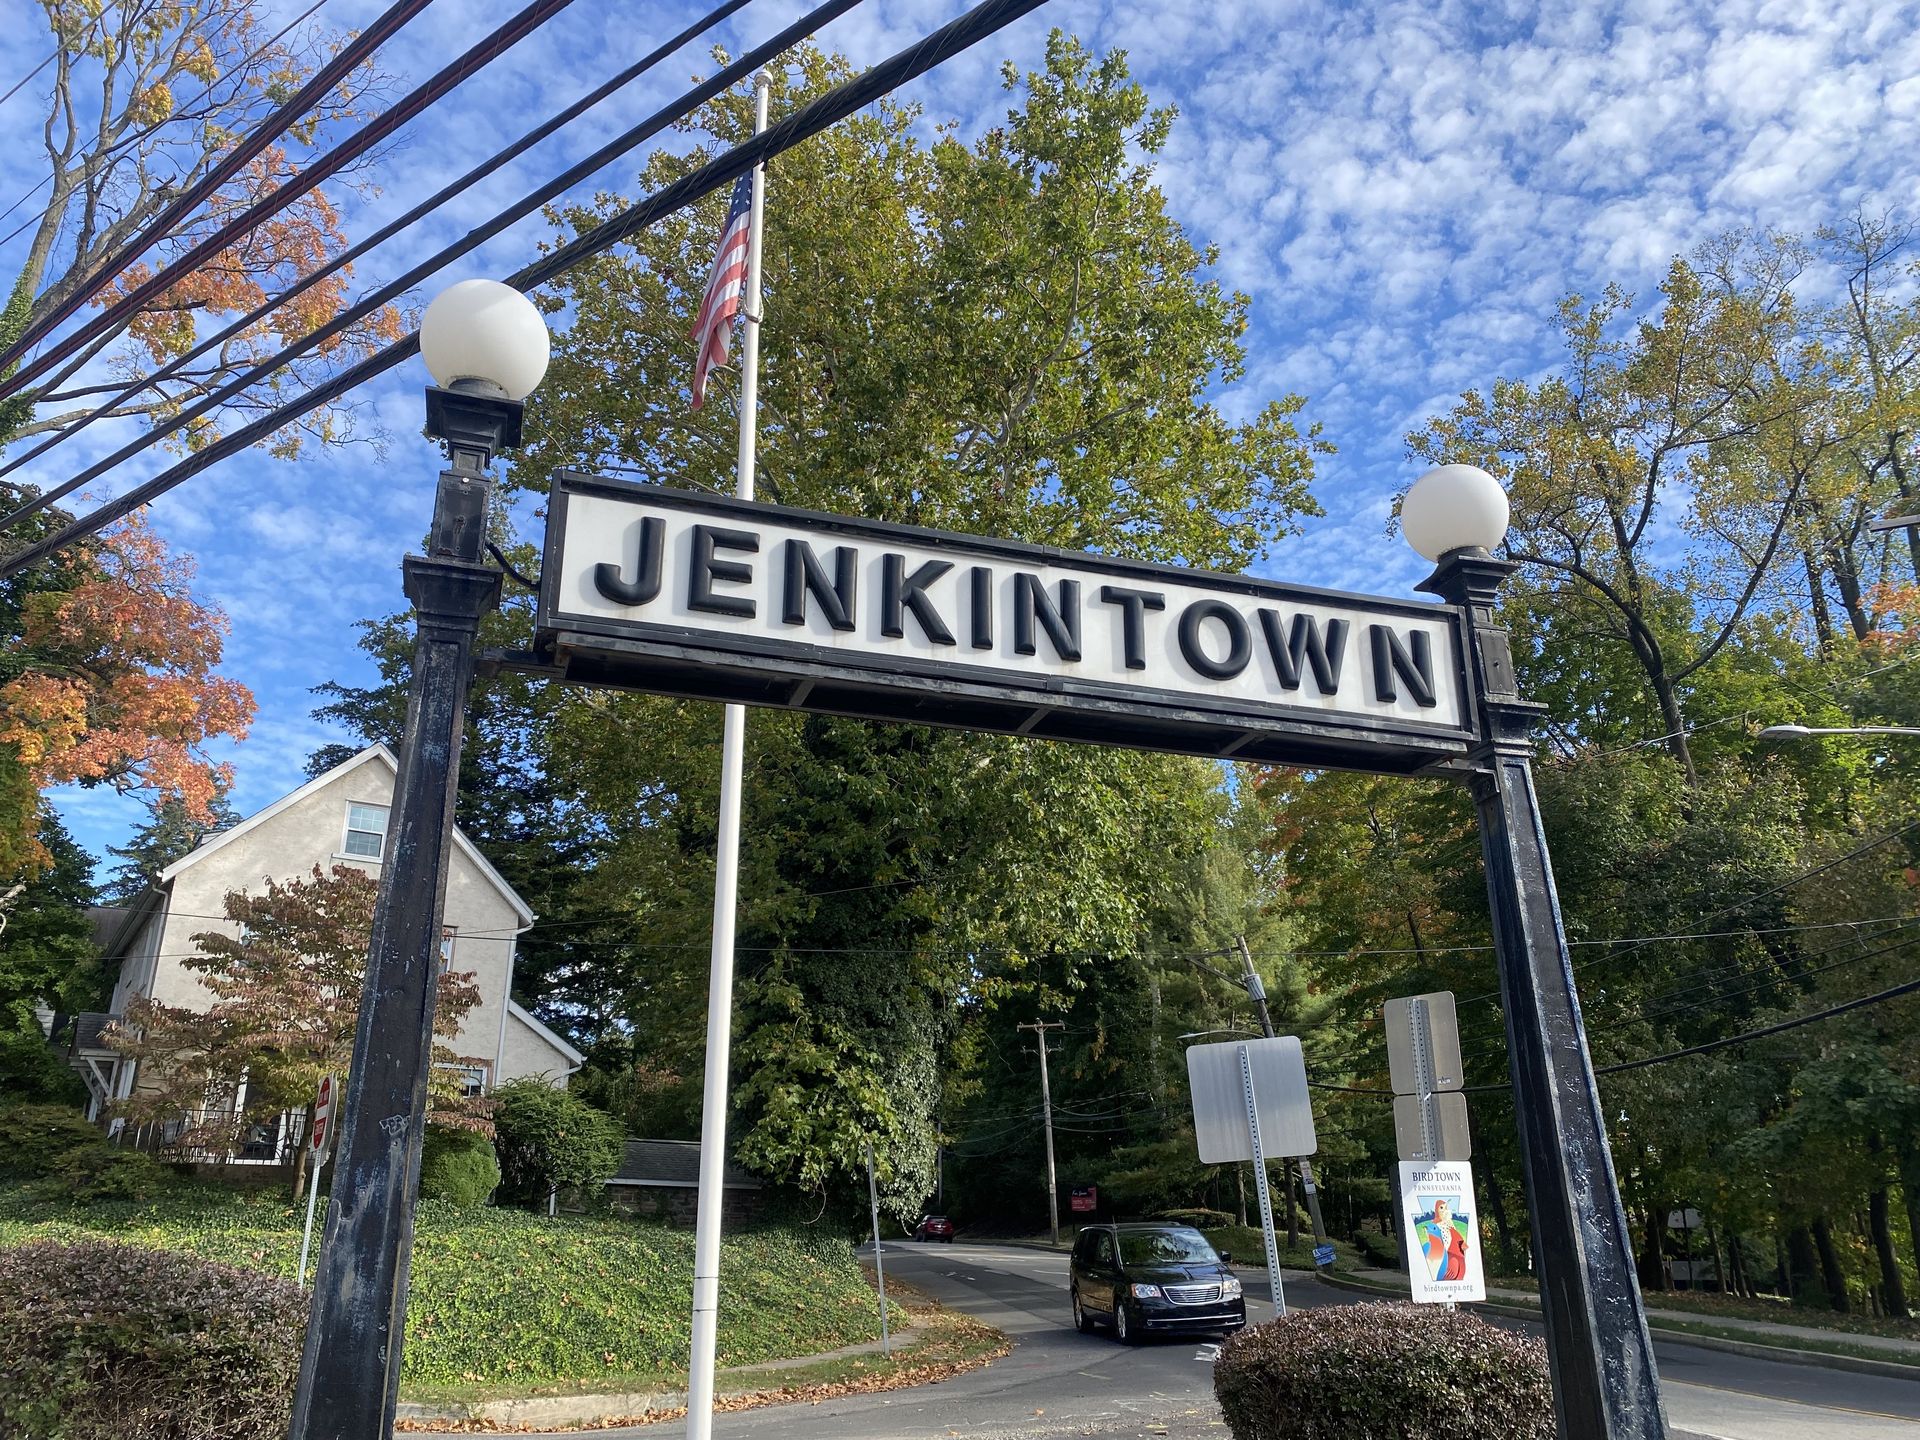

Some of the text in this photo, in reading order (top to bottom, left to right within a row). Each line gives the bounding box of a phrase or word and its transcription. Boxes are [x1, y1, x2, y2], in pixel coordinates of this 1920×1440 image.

[594, 516, 1438, 708] JENKINTOWN
[1412, 1172, 1461, 1182] BIRD TOWN
[1424, 1285, 1474, 1293] birdtownpa.org
